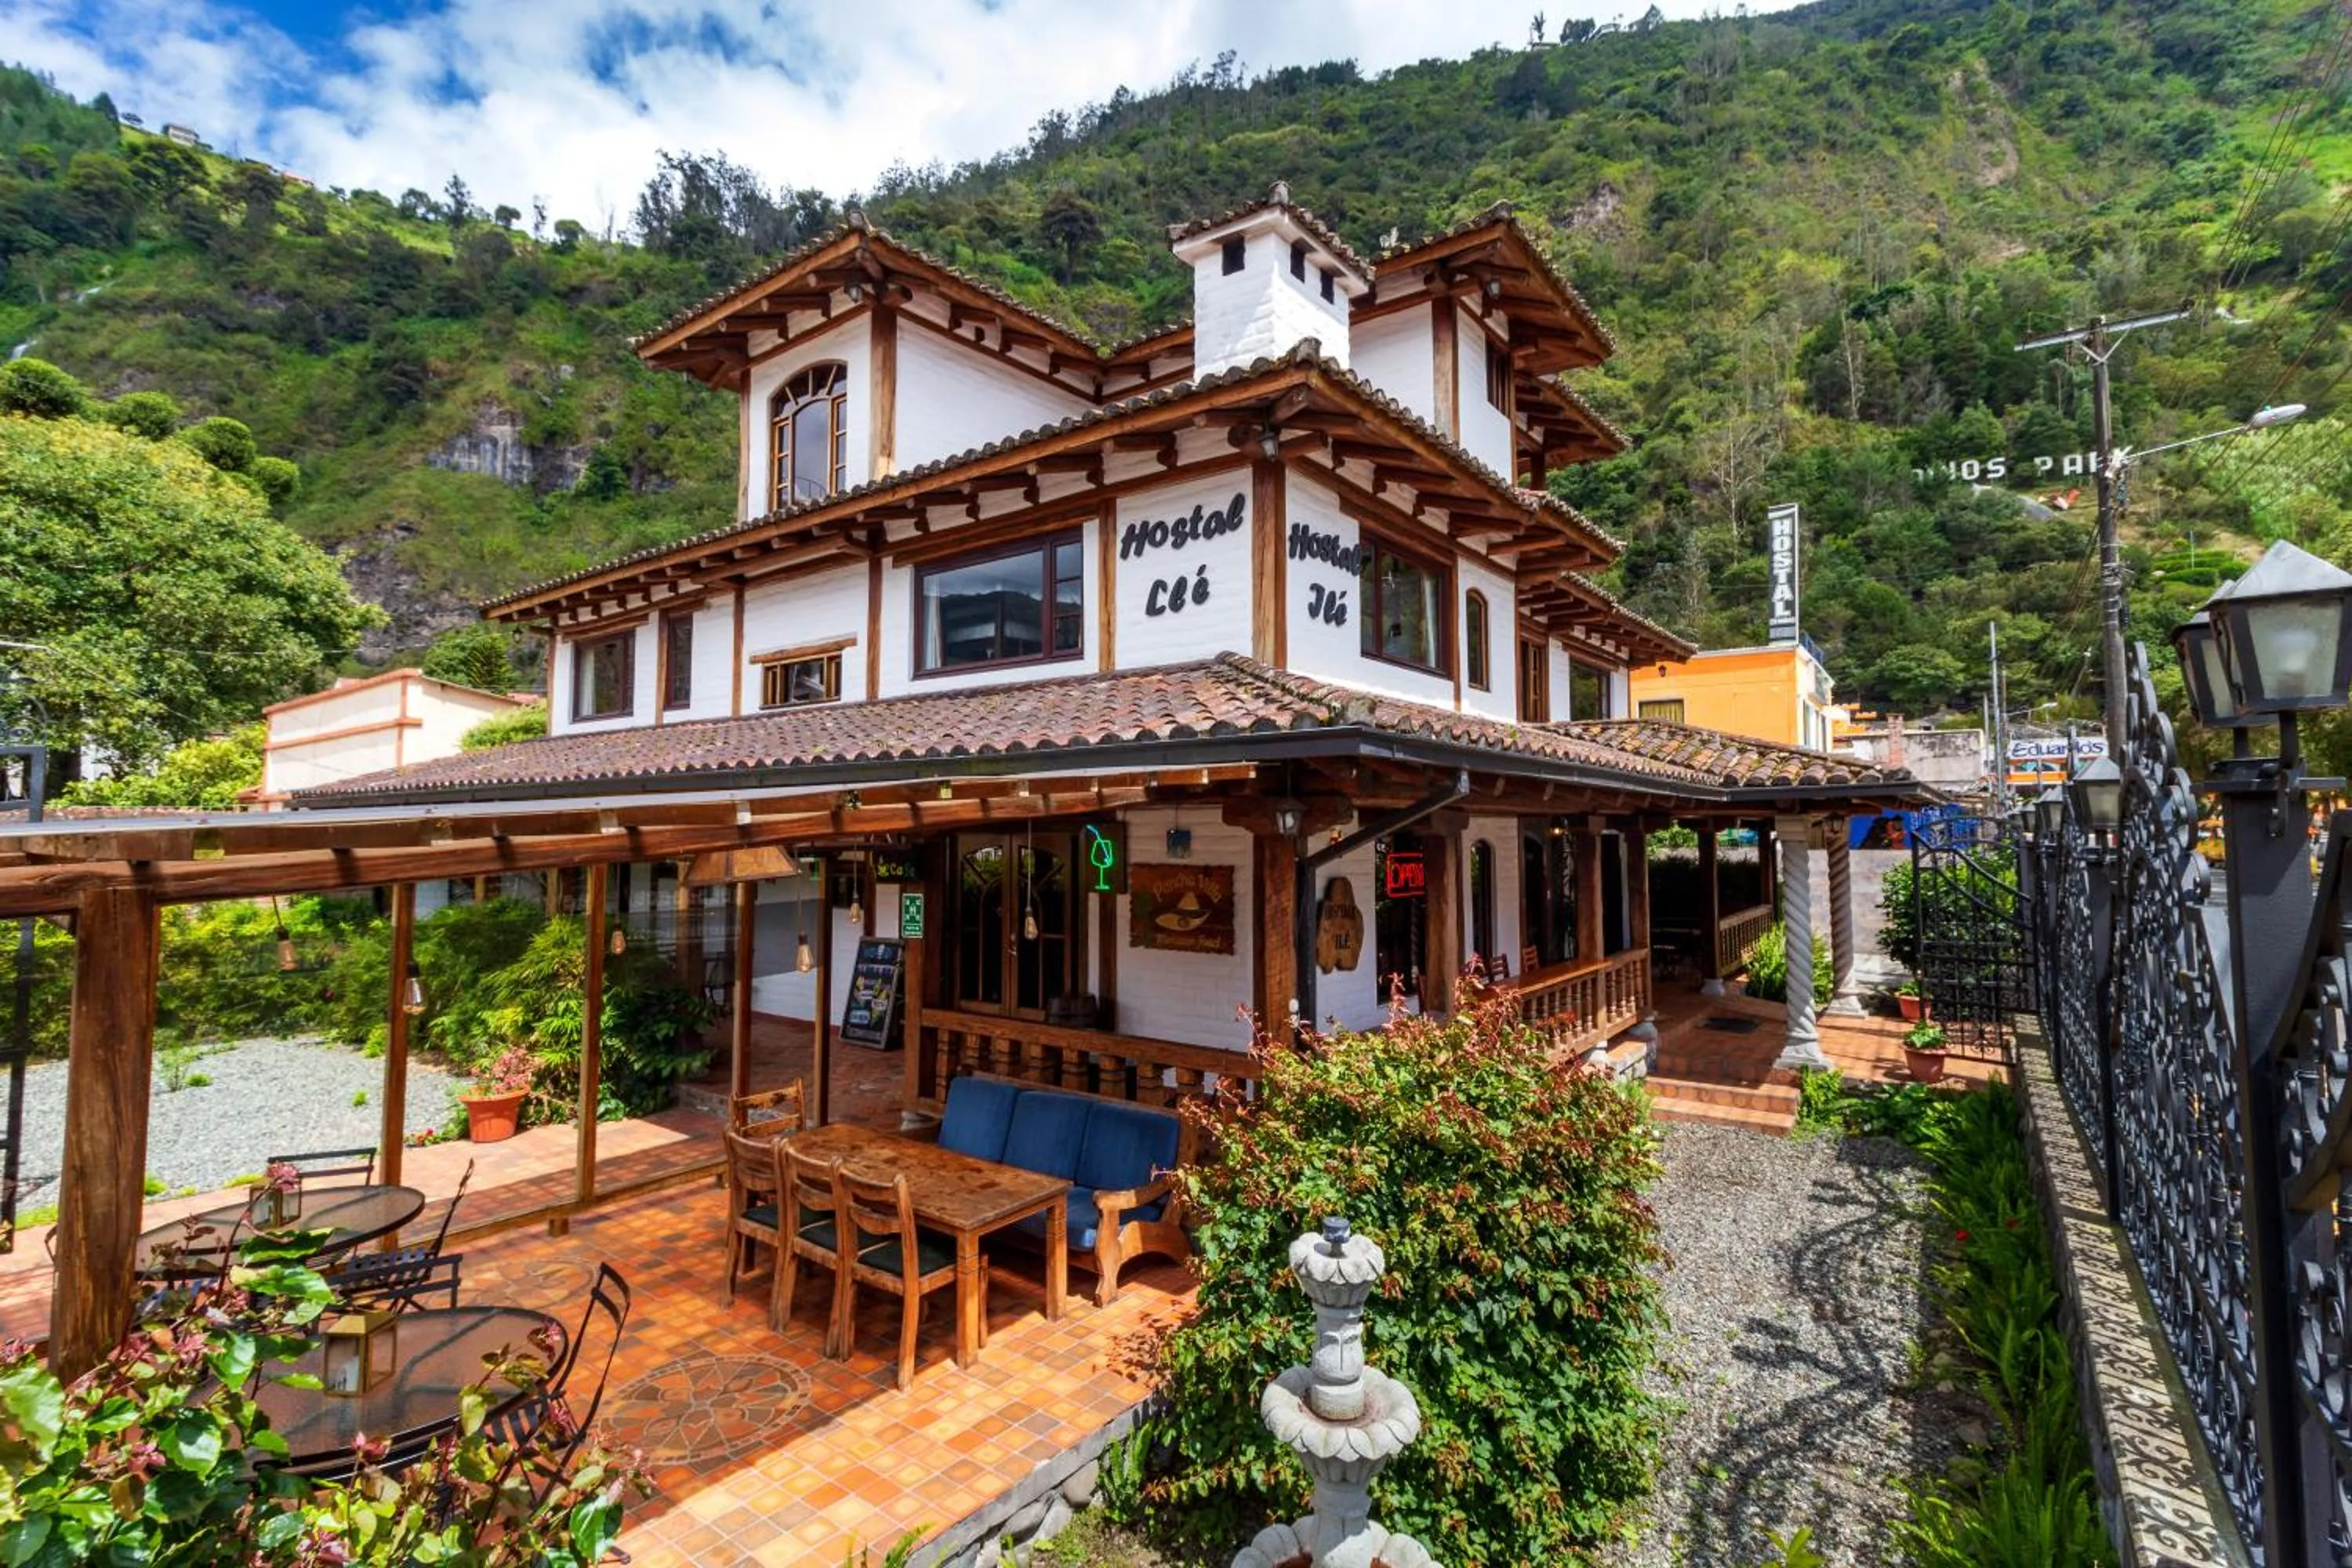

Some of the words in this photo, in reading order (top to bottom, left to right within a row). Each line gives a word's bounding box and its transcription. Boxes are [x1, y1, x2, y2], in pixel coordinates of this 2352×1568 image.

[1120, 492, 1245, 560] Hostal
[1288, 522, 1360, 576] Hostal
[1772, 518, 1794, 618] HOSTAL
[1391, 862, 1425, 887] OPEN
